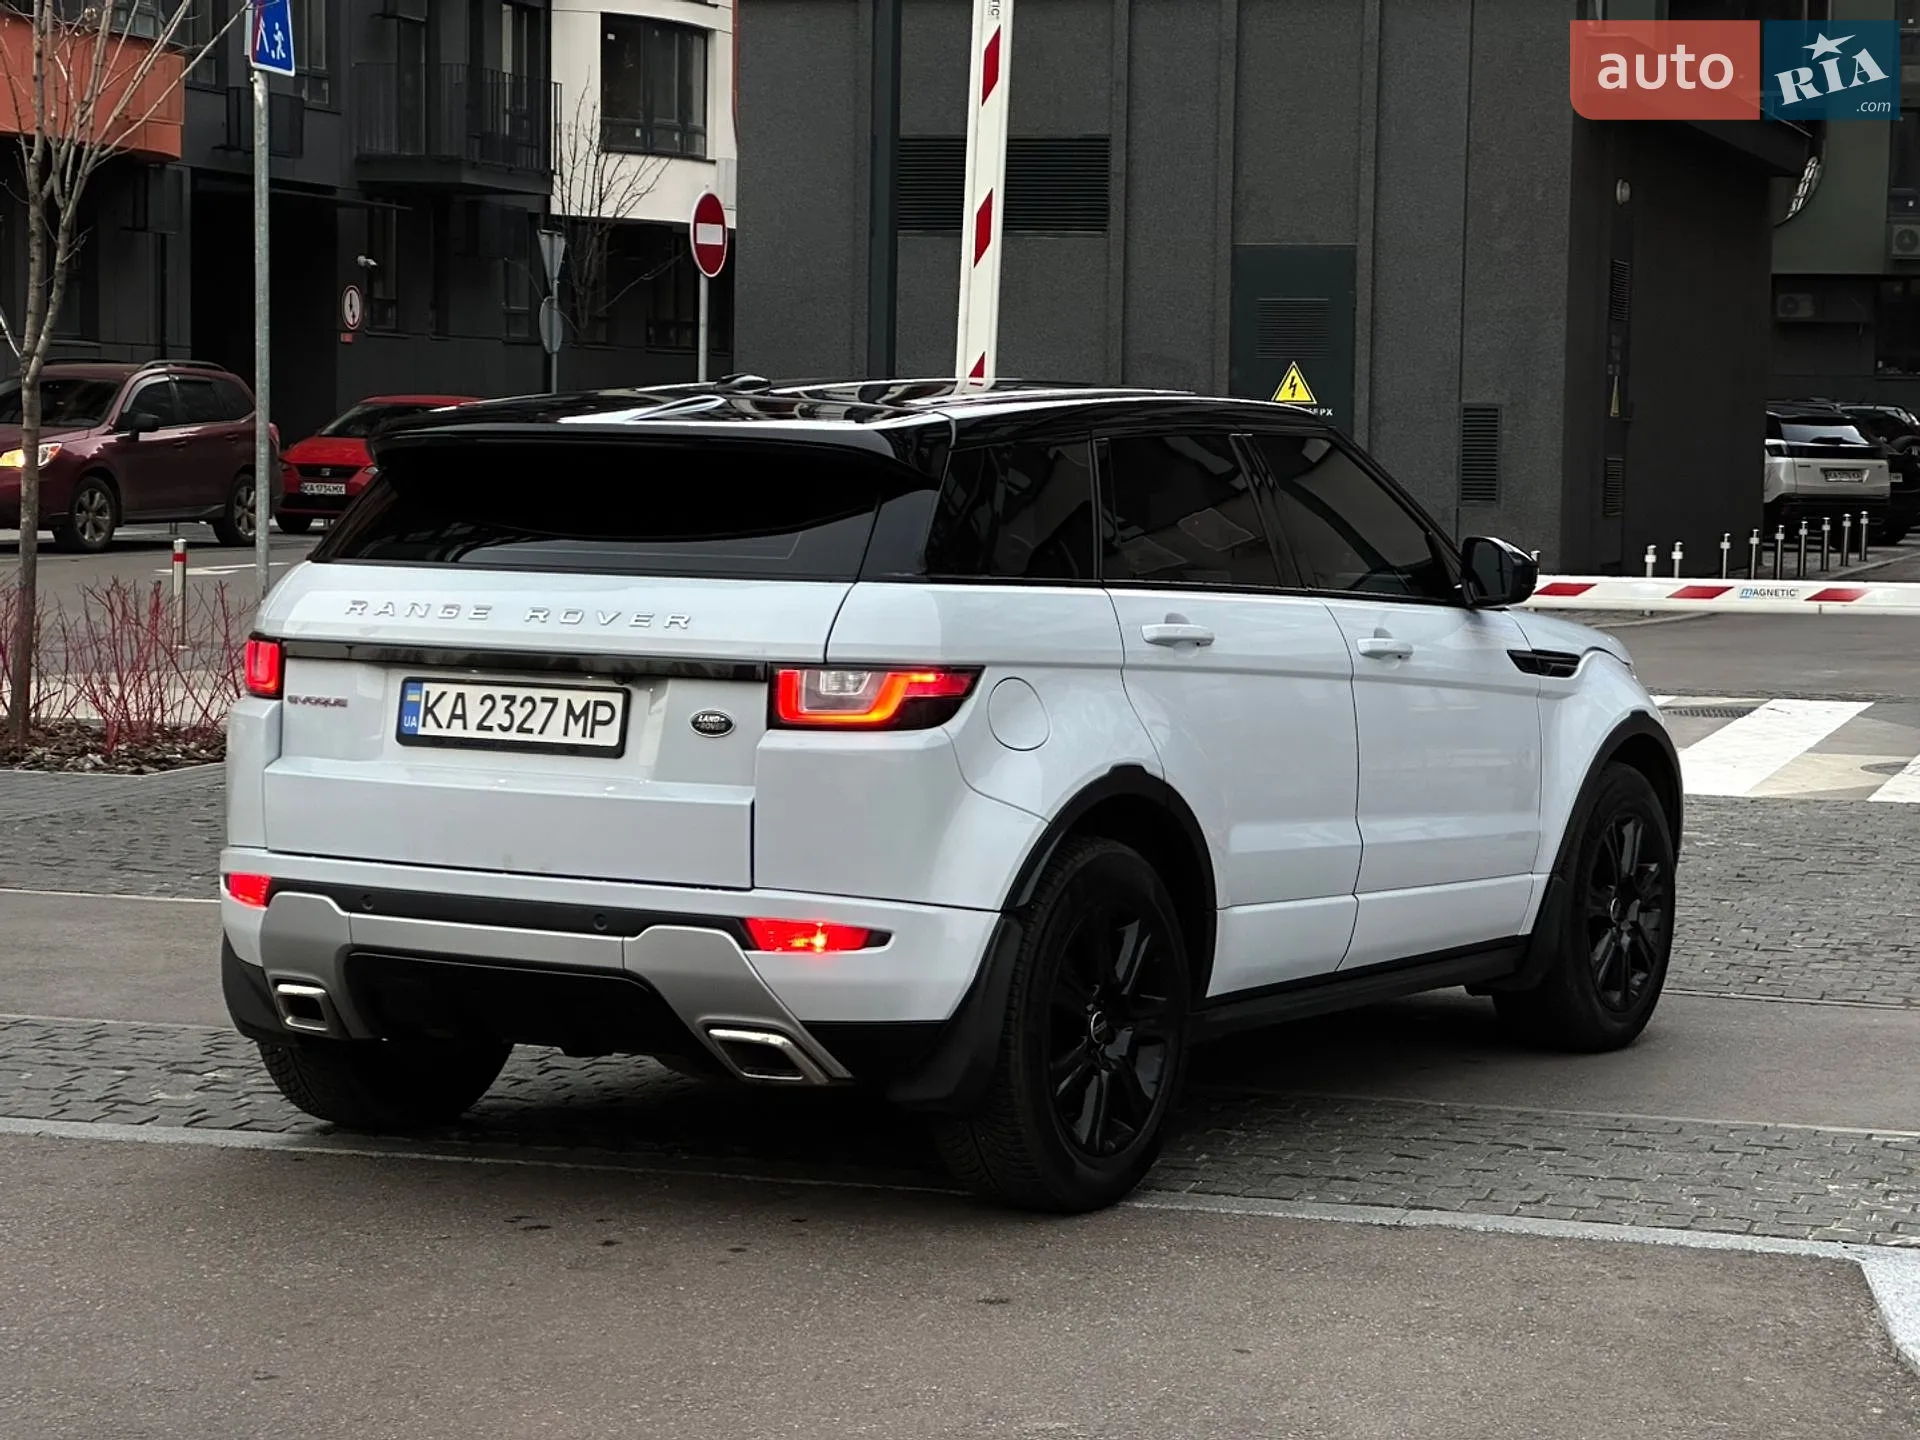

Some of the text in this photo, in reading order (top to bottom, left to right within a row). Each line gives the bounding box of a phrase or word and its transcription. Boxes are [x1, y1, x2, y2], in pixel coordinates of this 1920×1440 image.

[344, 600, 692, 630] RANGE ROVER
[404, 715, 417, 728] UA
[421, 690, 616, 739] KA 2327 MP
